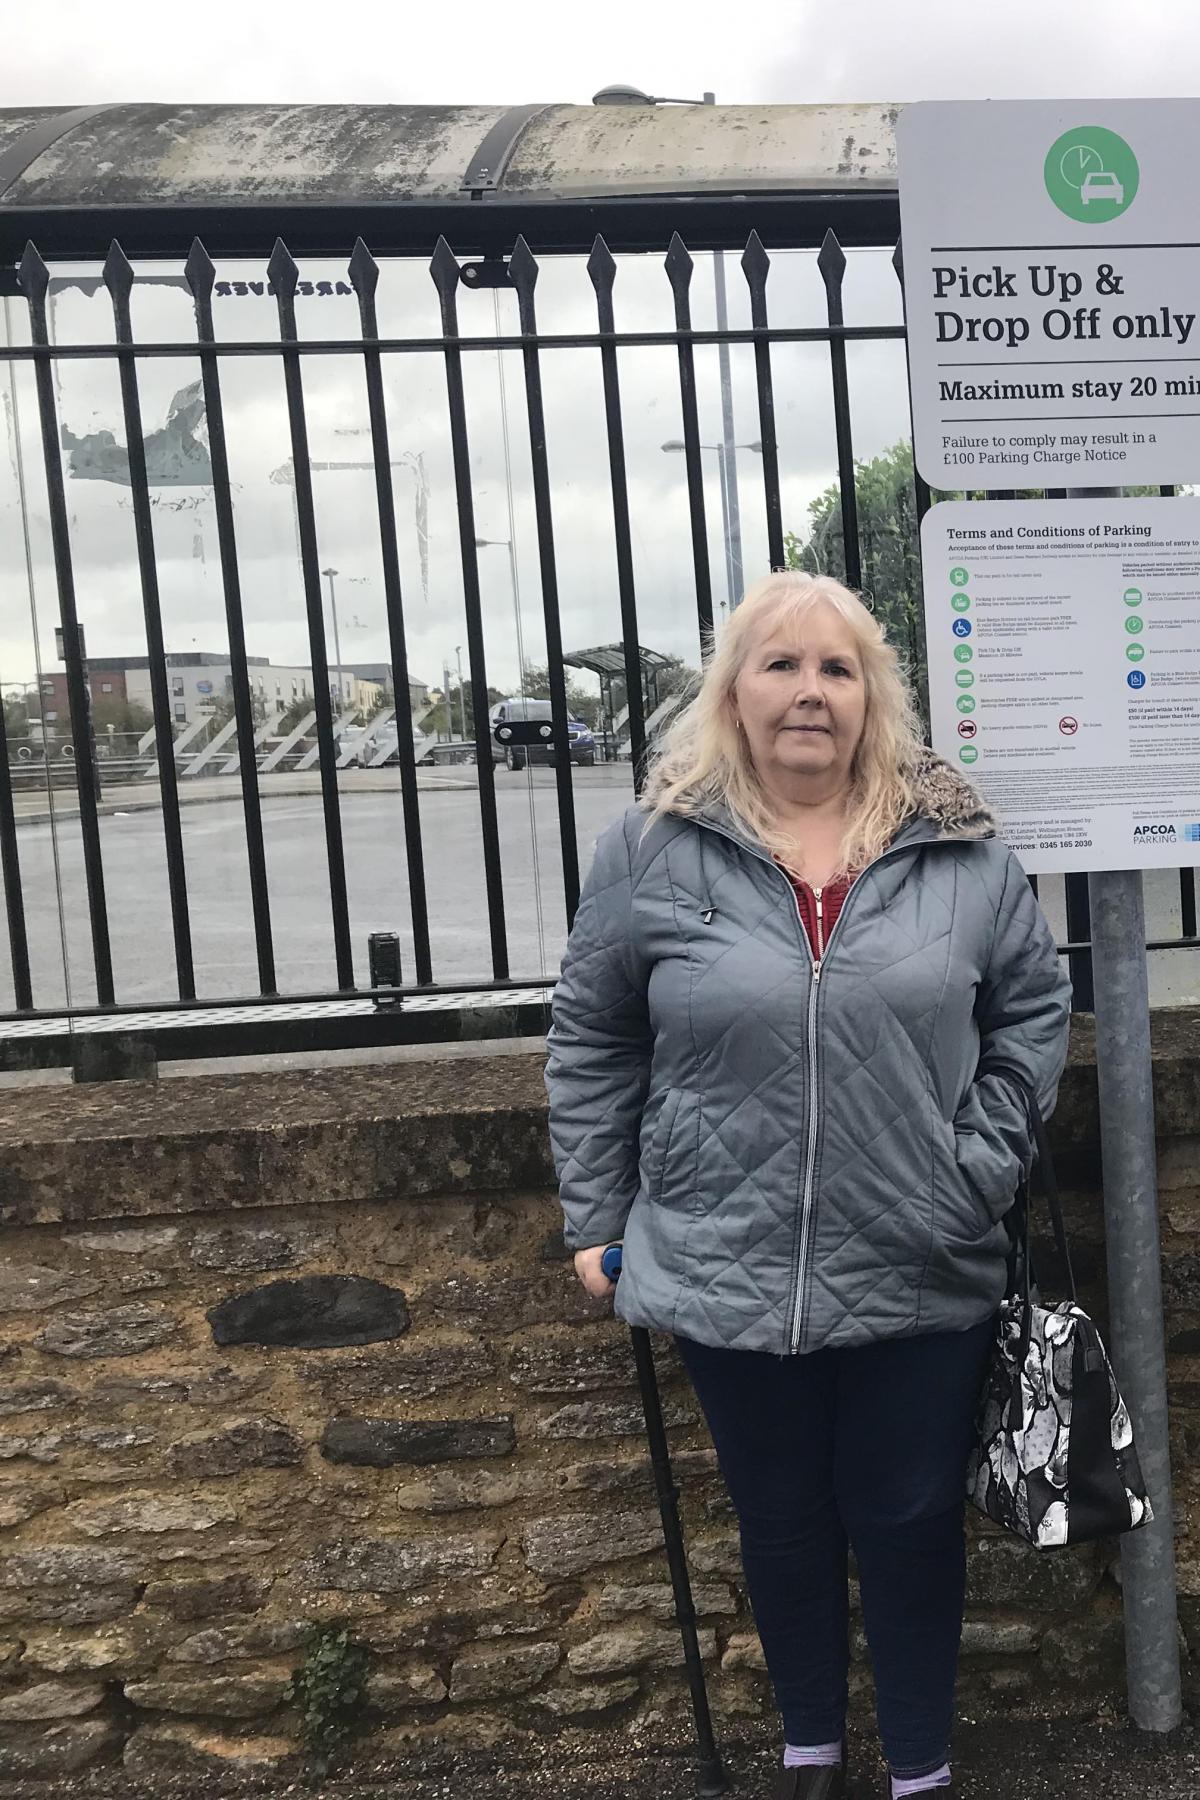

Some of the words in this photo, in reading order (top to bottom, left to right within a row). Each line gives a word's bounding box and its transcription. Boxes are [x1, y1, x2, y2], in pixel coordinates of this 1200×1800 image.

[932, 266, 1017, 298] Pick
[1028, 265, 1082, 302] Up
[1096, 263, 1124, 296] &
[935, 311, 1029, 347] Drop
[1042, 307, 1100, 340] Off
[1112, 306, 1195, 344] only
[939, 379, 1064, 401] Maximum
[1072, 379, 1122, 401] stay
[1130, 376, 1157, 397] 20
[942, 435, 989, 448] Failure
[992, 436, 1006, 447] to
[1009, 434, 1056, 450] comply
[1060, 436, 1088, 449] may
[1091, 432, 1129, 445] result
[1132, 431, 1145, 443] in
[1148, 434, 1157, 443] a
[943, 452, 975, 465] £100
[979, 451, 1029, 466] Parking
[1033, 449, 1081, 464] Charge
[1084, 448, 1127, 461] Notice
[946, 528, 987, 539] Terms
[990, 527, 1013, 538] and
[1017, 525, 1085, 538] Conditions
[1088, 525, 1100, 536] of
[1103, 524, 1152, 538] Parking
[1093, 541, 1120, 549] parking
[1133, 824, 1176, 835] APCOA
[1133, 834, 1177, 844] PARKING
